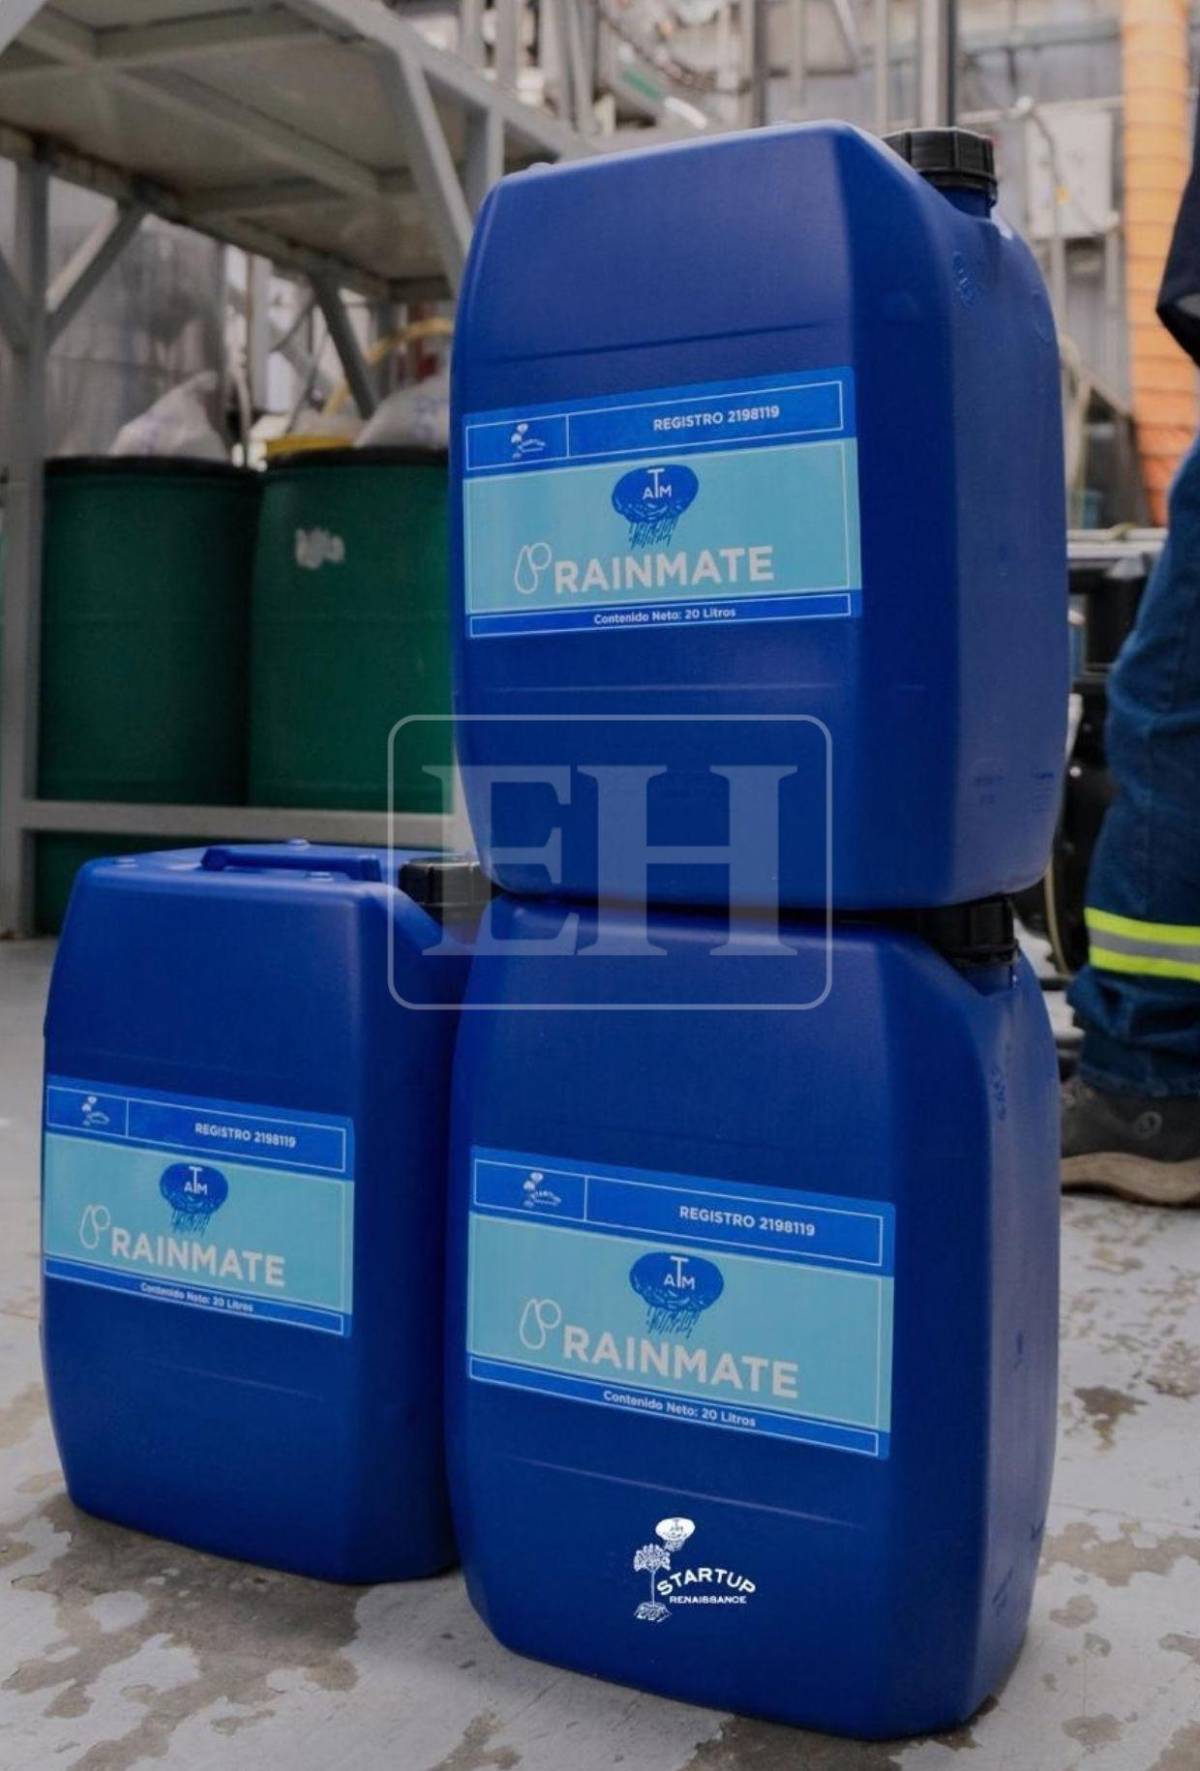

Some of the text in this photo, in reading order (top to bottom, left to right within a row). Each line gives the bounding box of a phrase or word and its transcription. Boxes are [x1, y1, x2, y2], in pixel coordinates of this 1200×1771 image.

[653, 405, 781, 432] REGISTRO 2198119
[553, 545, 776, 595] RAINMATE
[593, 606, 737, 625] Contenido Neto: 20 Litros
[194, 1122, 298, 1149] REGISTRO 2198119
[678, 1205, 817, 1238] REGISTRO 2198119
[109, 1226, 287, 1288] RAINMATE
[562, 1324, 800, 1399] RAINMATE
[602, 1389, 757, 1428] Contenido Neto: 20 Litros
